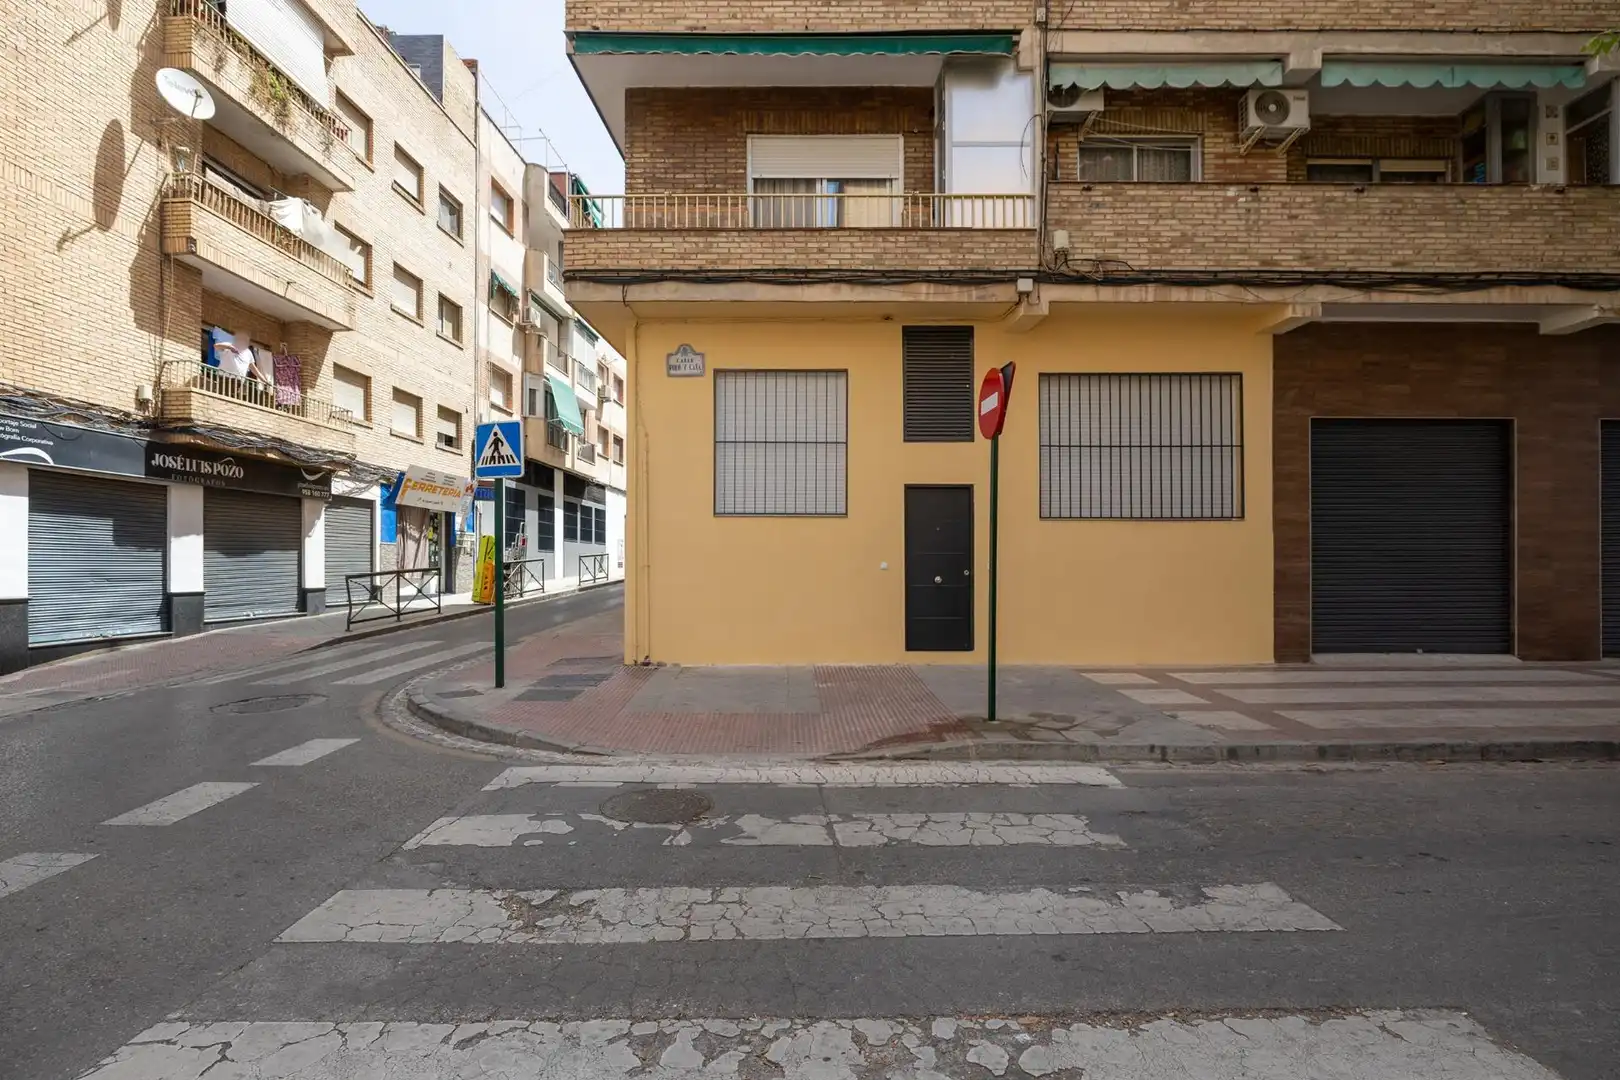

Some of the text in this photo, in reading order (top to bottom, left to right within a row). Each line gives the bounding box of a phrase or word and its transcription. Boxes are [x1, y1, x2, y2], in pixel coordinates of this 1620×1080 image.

[20, 420, 37, 429] Social
[151, 453, 244, 479] JOSÉ LUIS POZO
